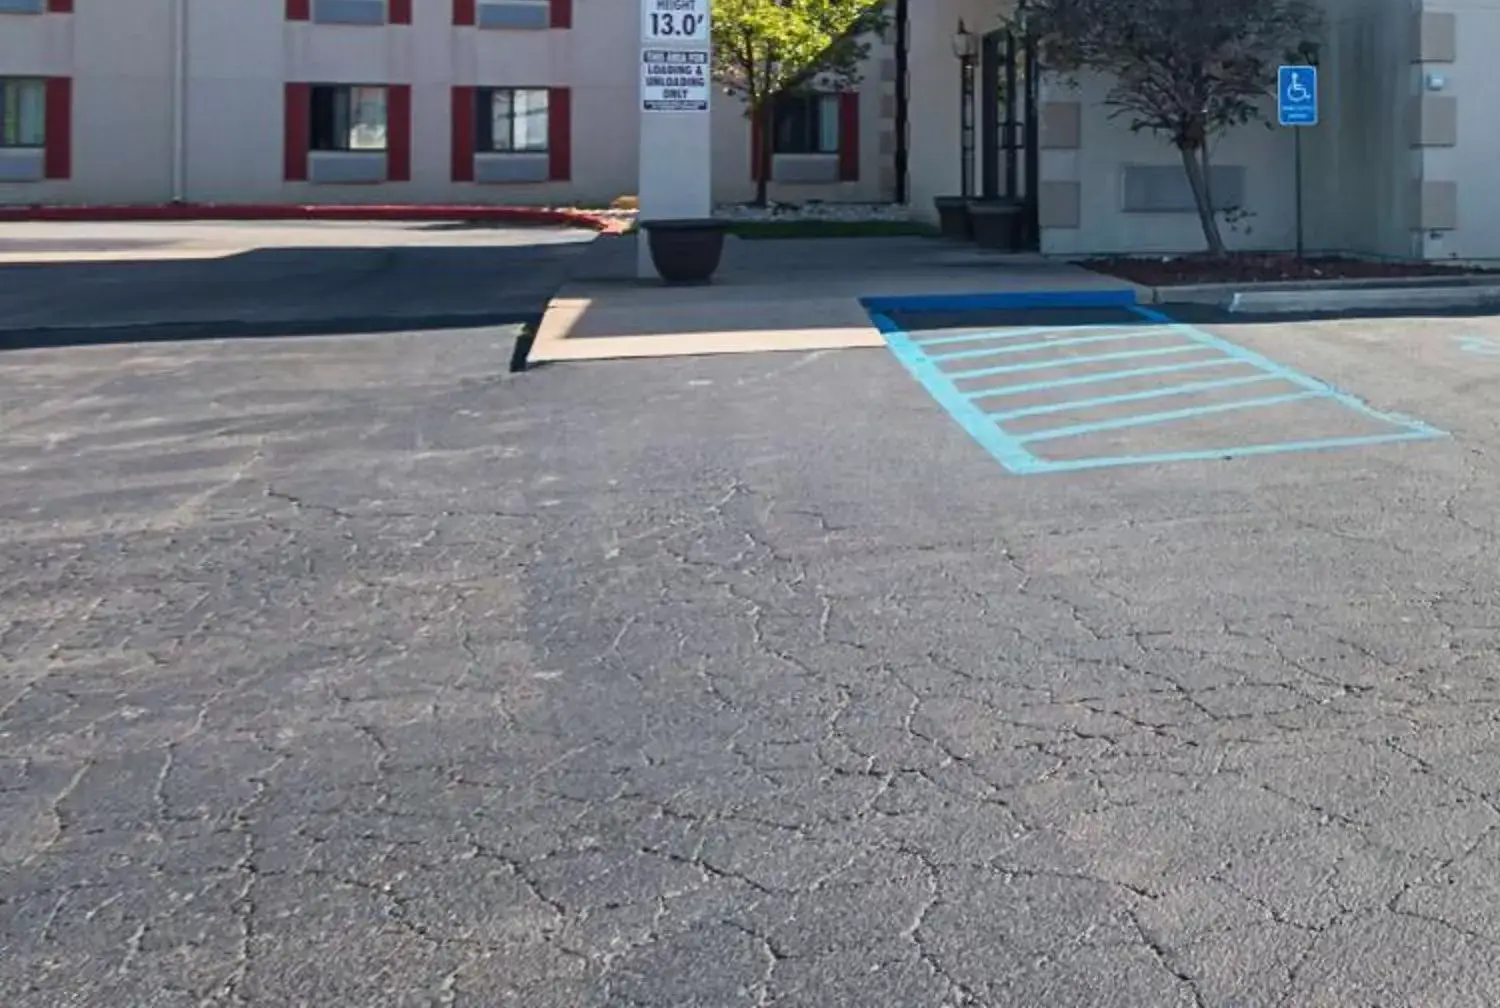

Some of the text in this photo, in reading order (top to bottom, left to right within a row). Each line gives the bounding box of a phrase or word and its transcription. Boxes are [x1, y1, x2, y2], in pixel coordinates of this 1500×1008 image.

[657, 0, 695, 11] HEIGHT
[651, 14, 704, 36] 13.0'
[647, 65, 692, 75] LOADING
[646, 77, 705, 87] UNLOADING
[663, 89, 688, 99] ONLY
